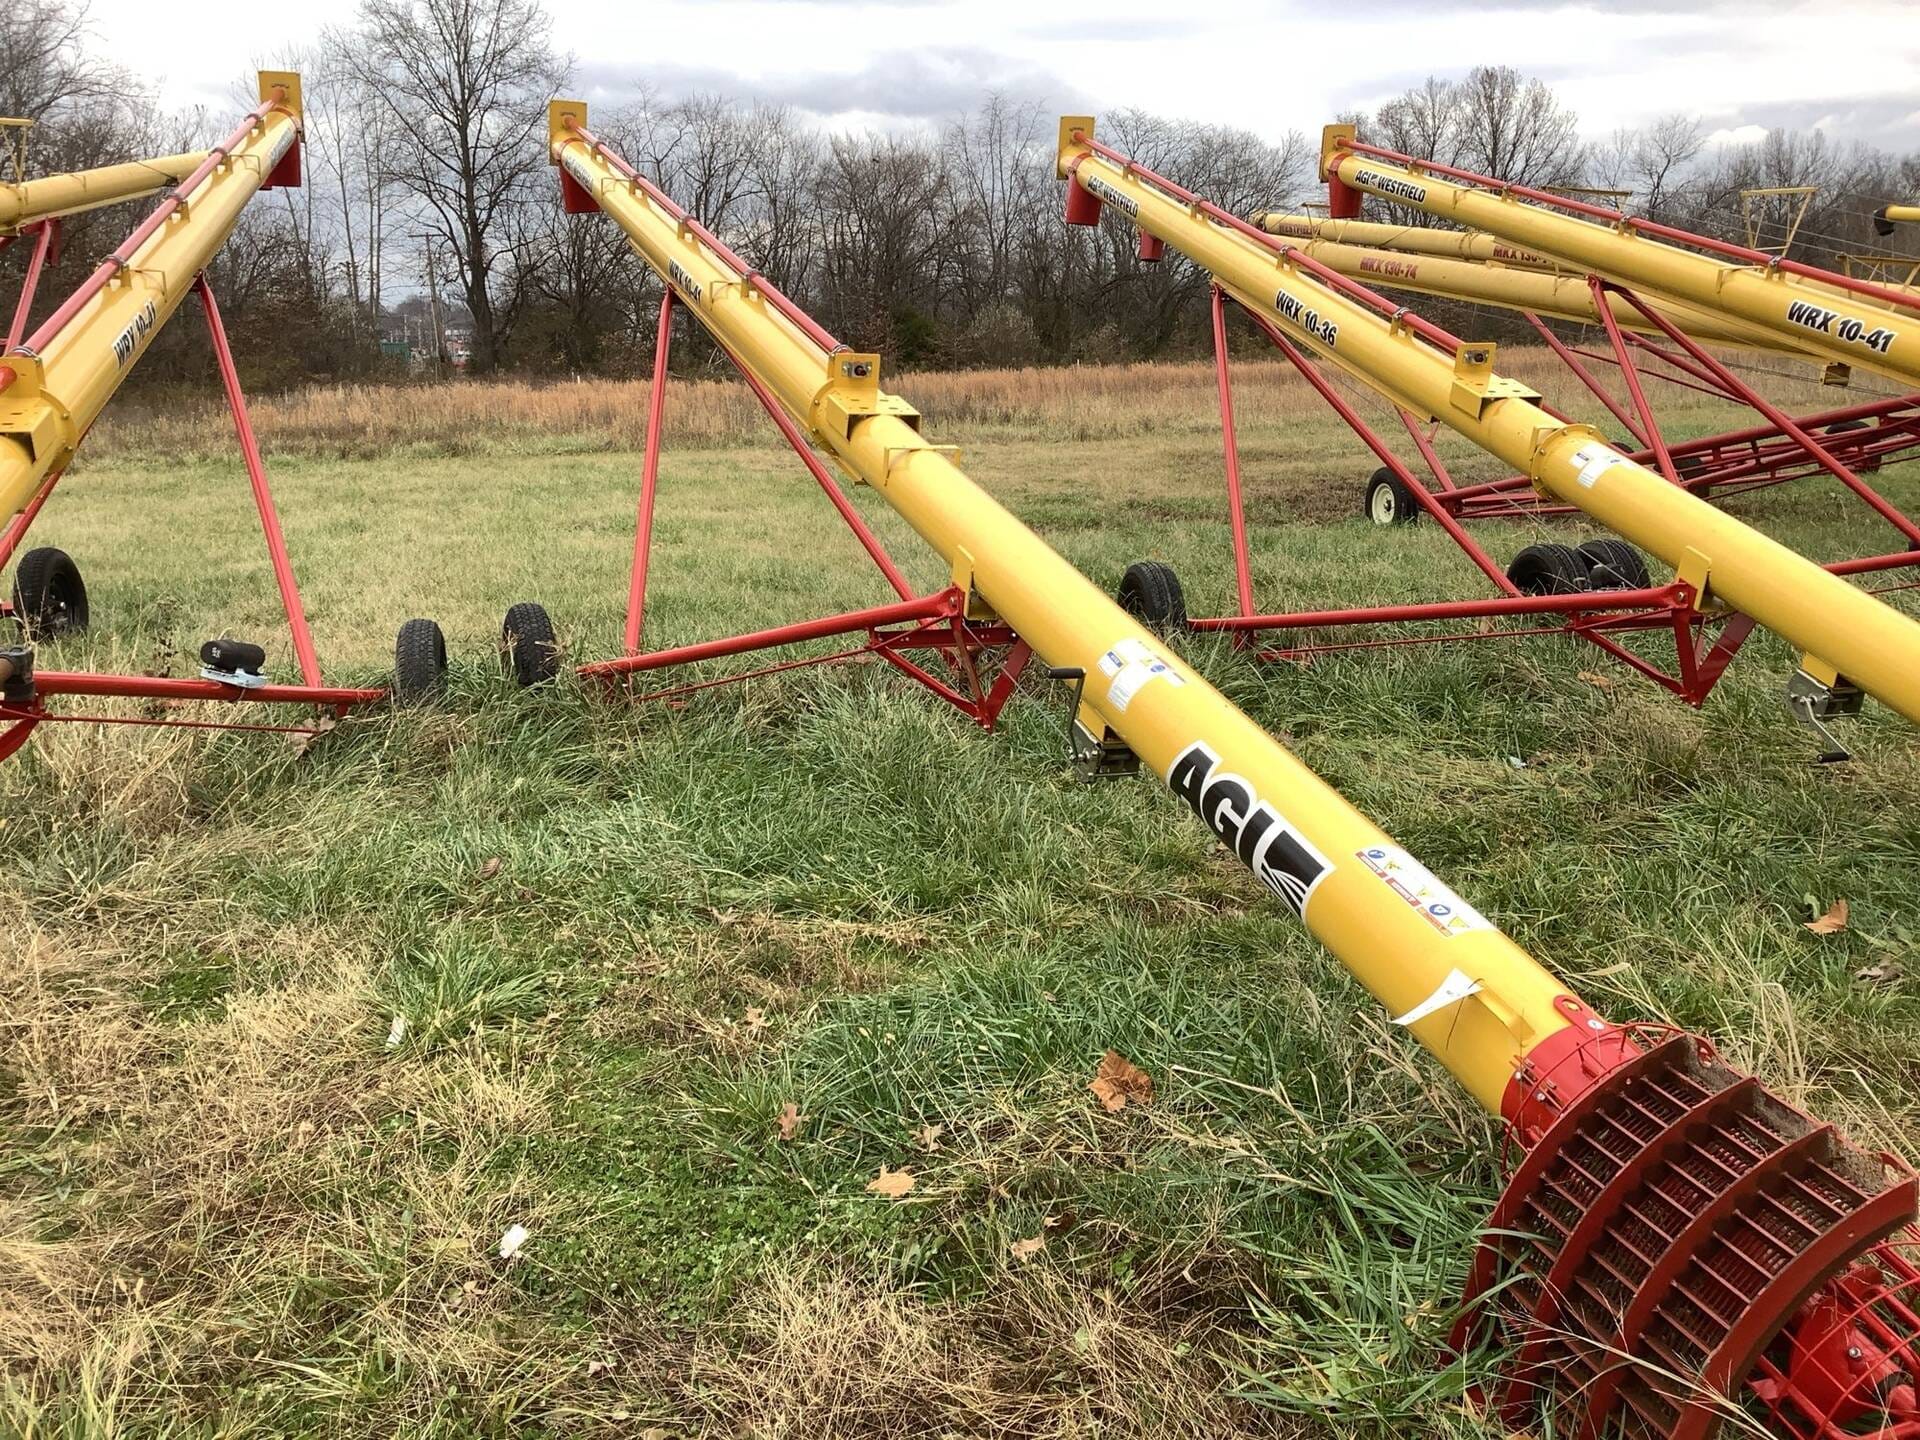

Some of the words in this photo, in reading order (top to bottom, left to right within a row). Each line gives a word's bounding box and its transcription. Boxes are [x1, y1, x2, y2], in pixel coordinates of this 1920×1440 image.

[1103, 184, 1138, 218] WESTFIELD
[1355, 170, 1371, 185] AGI
[1377, 176, 1426, 202] WESTFIELD
[1360, 257, 1385, 274] MKX
[1276, 290, 1303, 322] WRX
[1305, 311, 1337, 346] 10-36
[1788, 301, 1837, 333] WRX
[1838, 319, 1895, 352] 10-41
[1169, 746, 1275, 871] AGI
